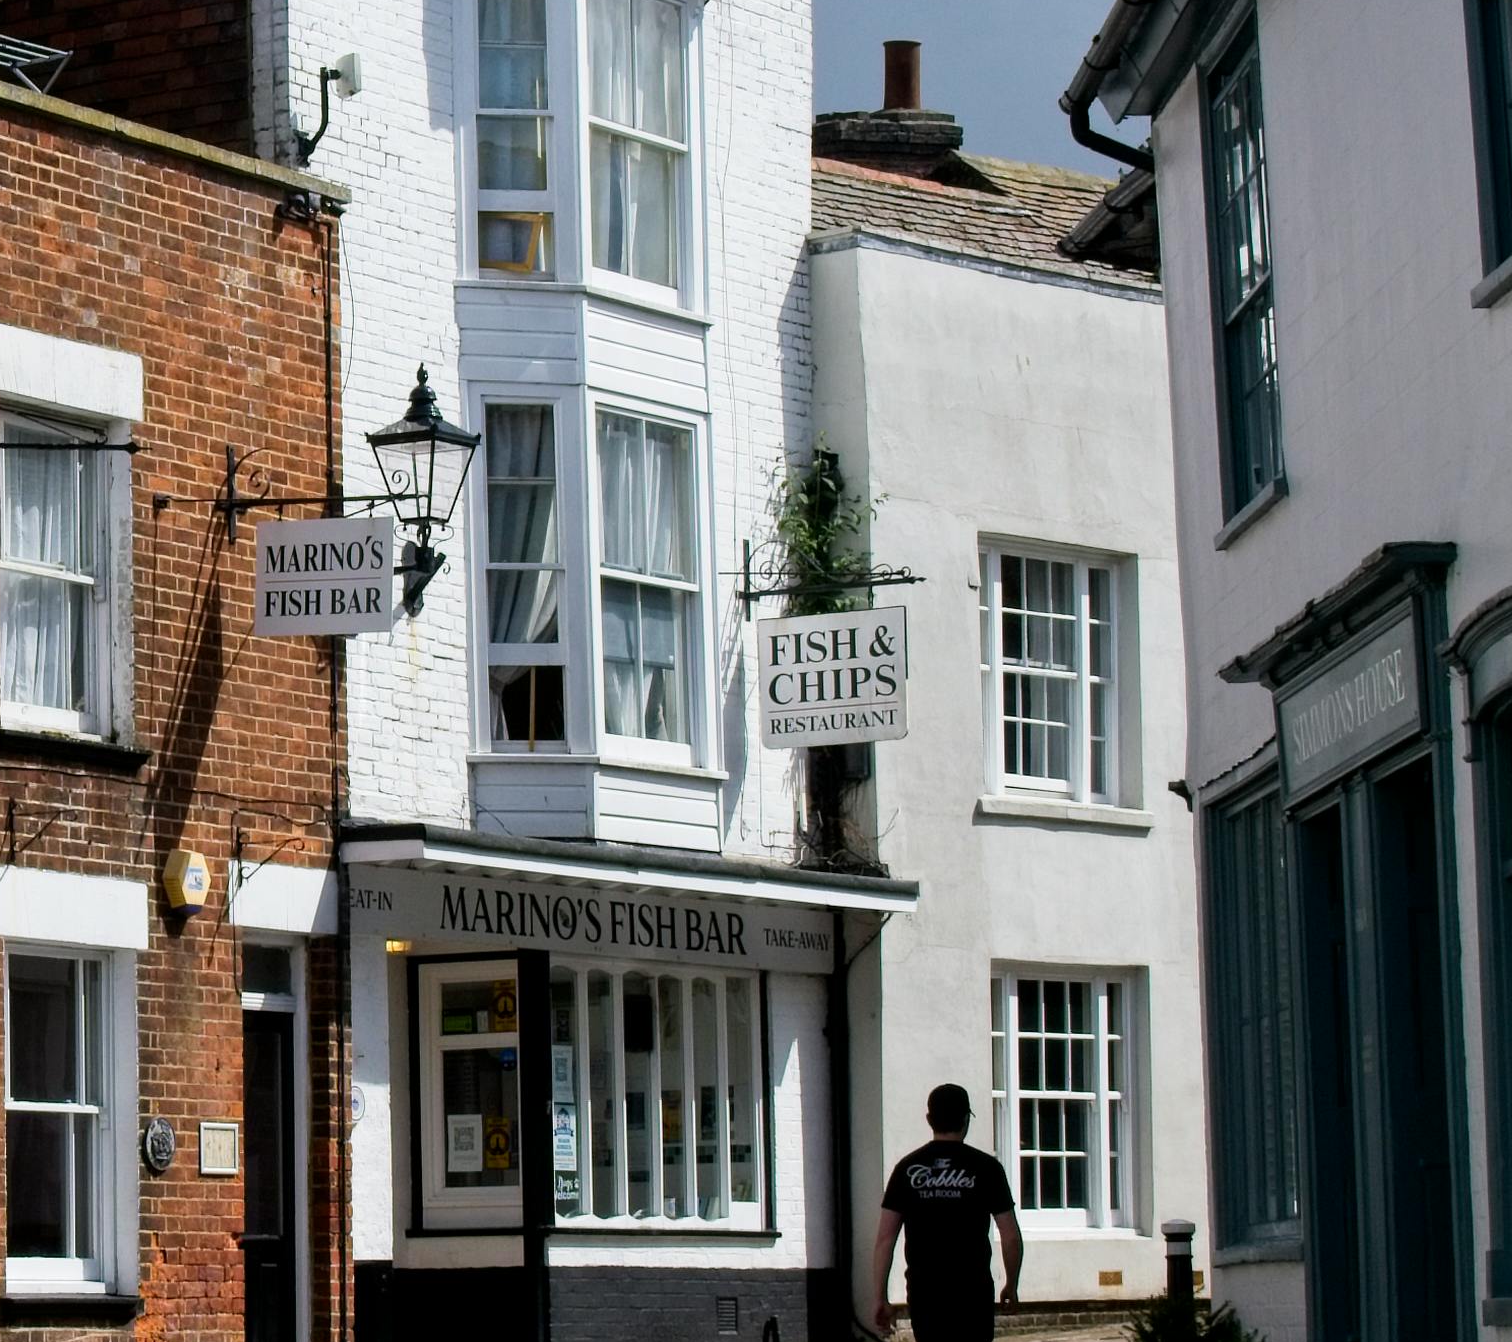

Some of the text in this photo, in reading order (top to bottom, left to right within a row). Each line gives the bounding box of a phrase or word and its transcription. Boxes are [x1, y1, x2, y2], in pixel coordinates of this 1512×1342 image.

[265, 535, 384, 574] MARINO'S
[264, 587, 382, 617] FISH BAR
[769, 625, 895, 667] FISH &
[768, 664, 897, 705] CHIPS
[1354, 649, 1405, 727] HOUSE
[770, 709, 898, 735] RESTAURANT
[349, 887, 393, 911] EAT-IN
[440, 884, 747, 956] MARINO'S FISH BAR
[764, 927, 832, 952] TAKE-AWAY
[907, 1164, 976, 1189] Cobbles
[918, 1188, 962, 1199] TEA ROOM
